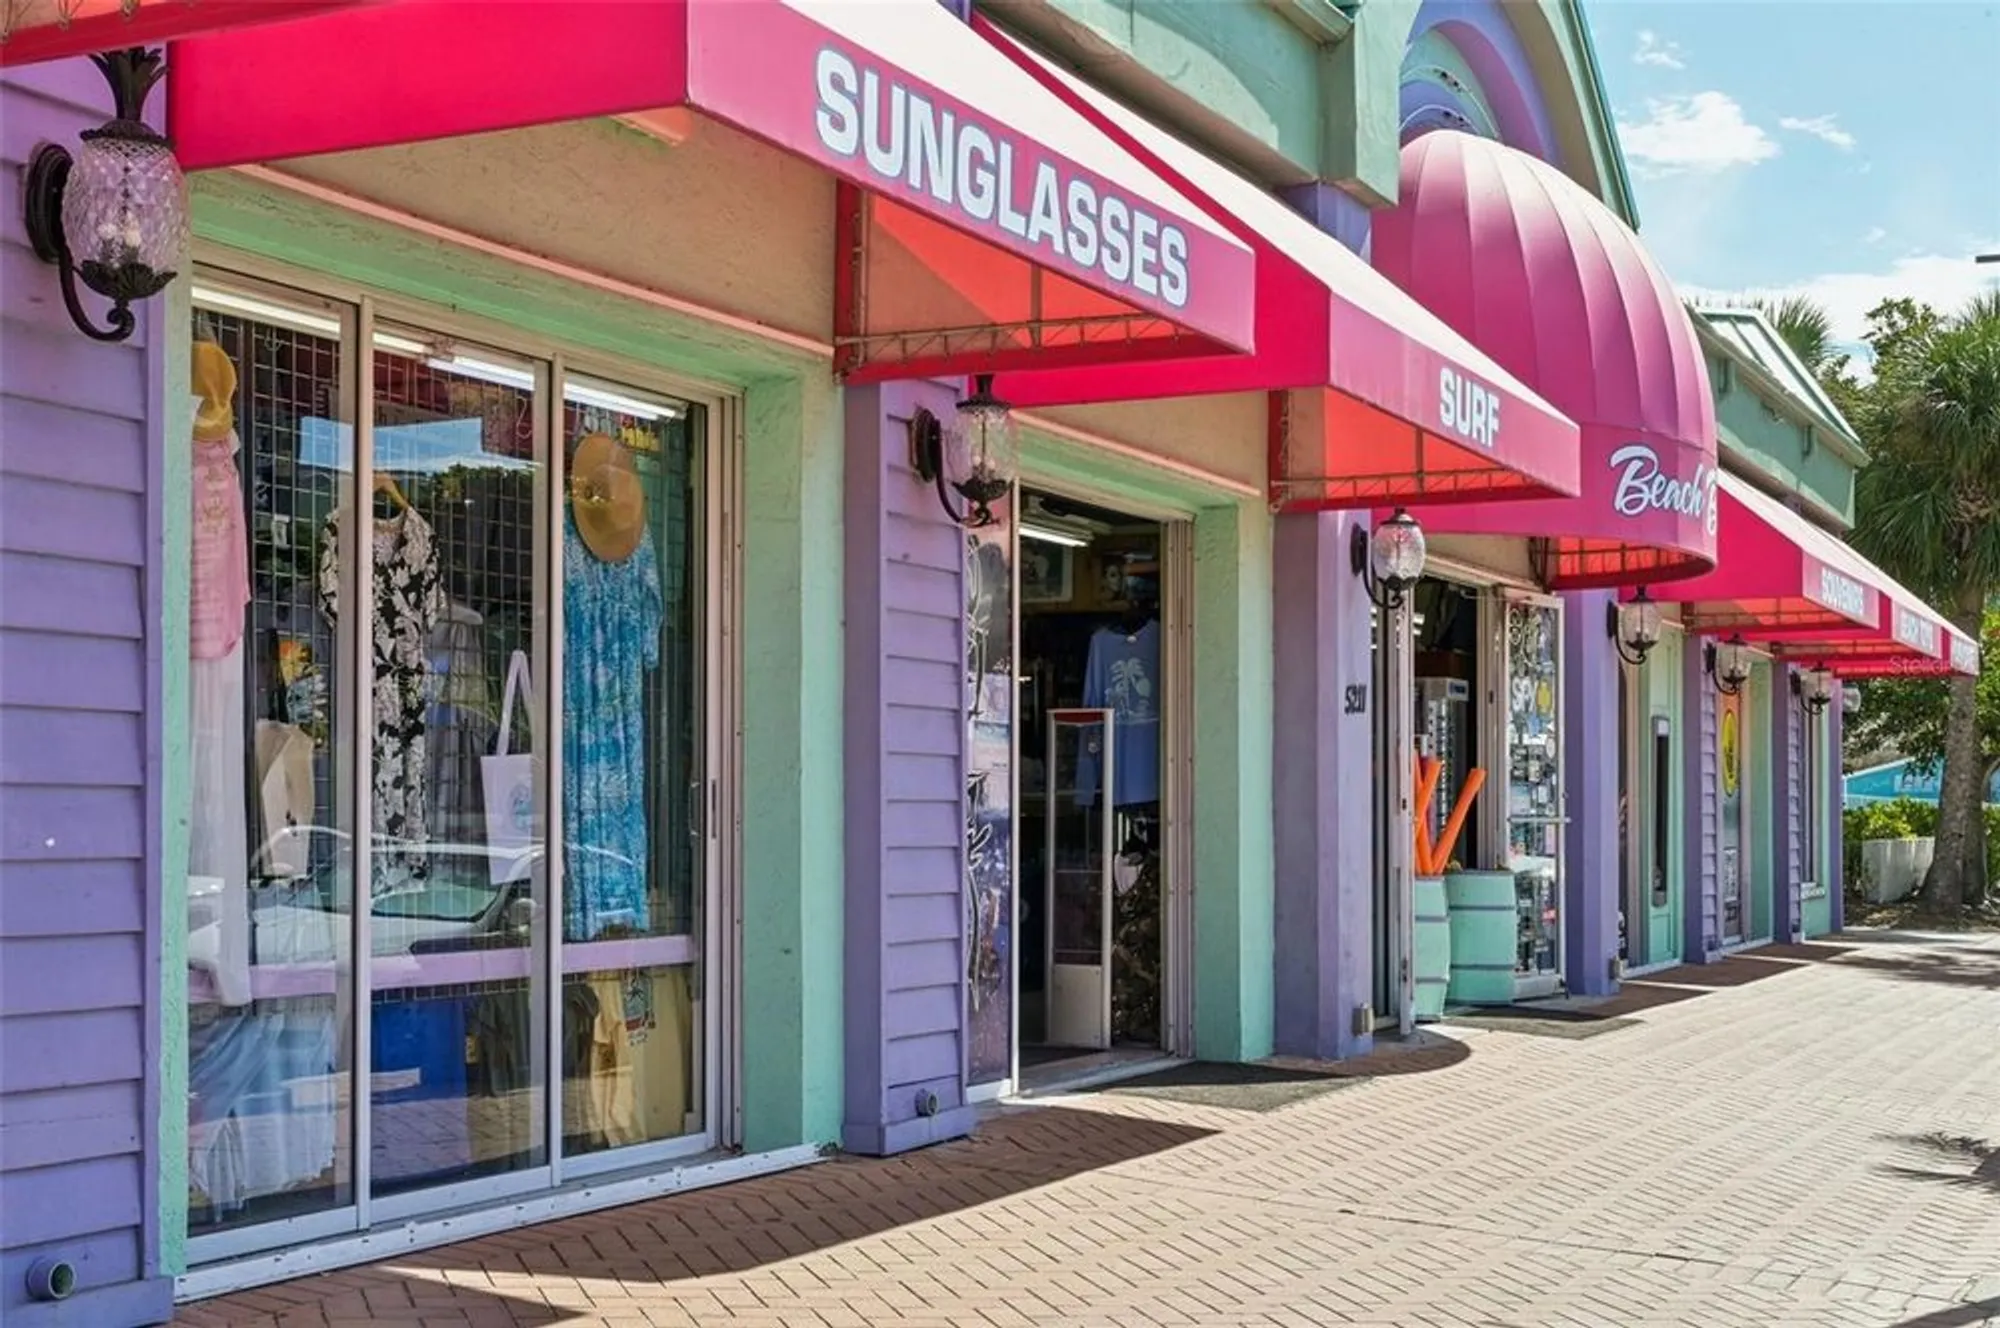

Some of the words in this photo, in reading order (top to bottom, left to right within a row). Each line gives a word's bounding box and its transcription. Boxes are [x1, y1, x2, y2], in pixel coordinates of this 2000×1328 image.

[816, 48, 1188, 308] SUNGLASSES
[1440, 367, 1499, 447] SURF
[1610, 445, 1703, 516] Beach
